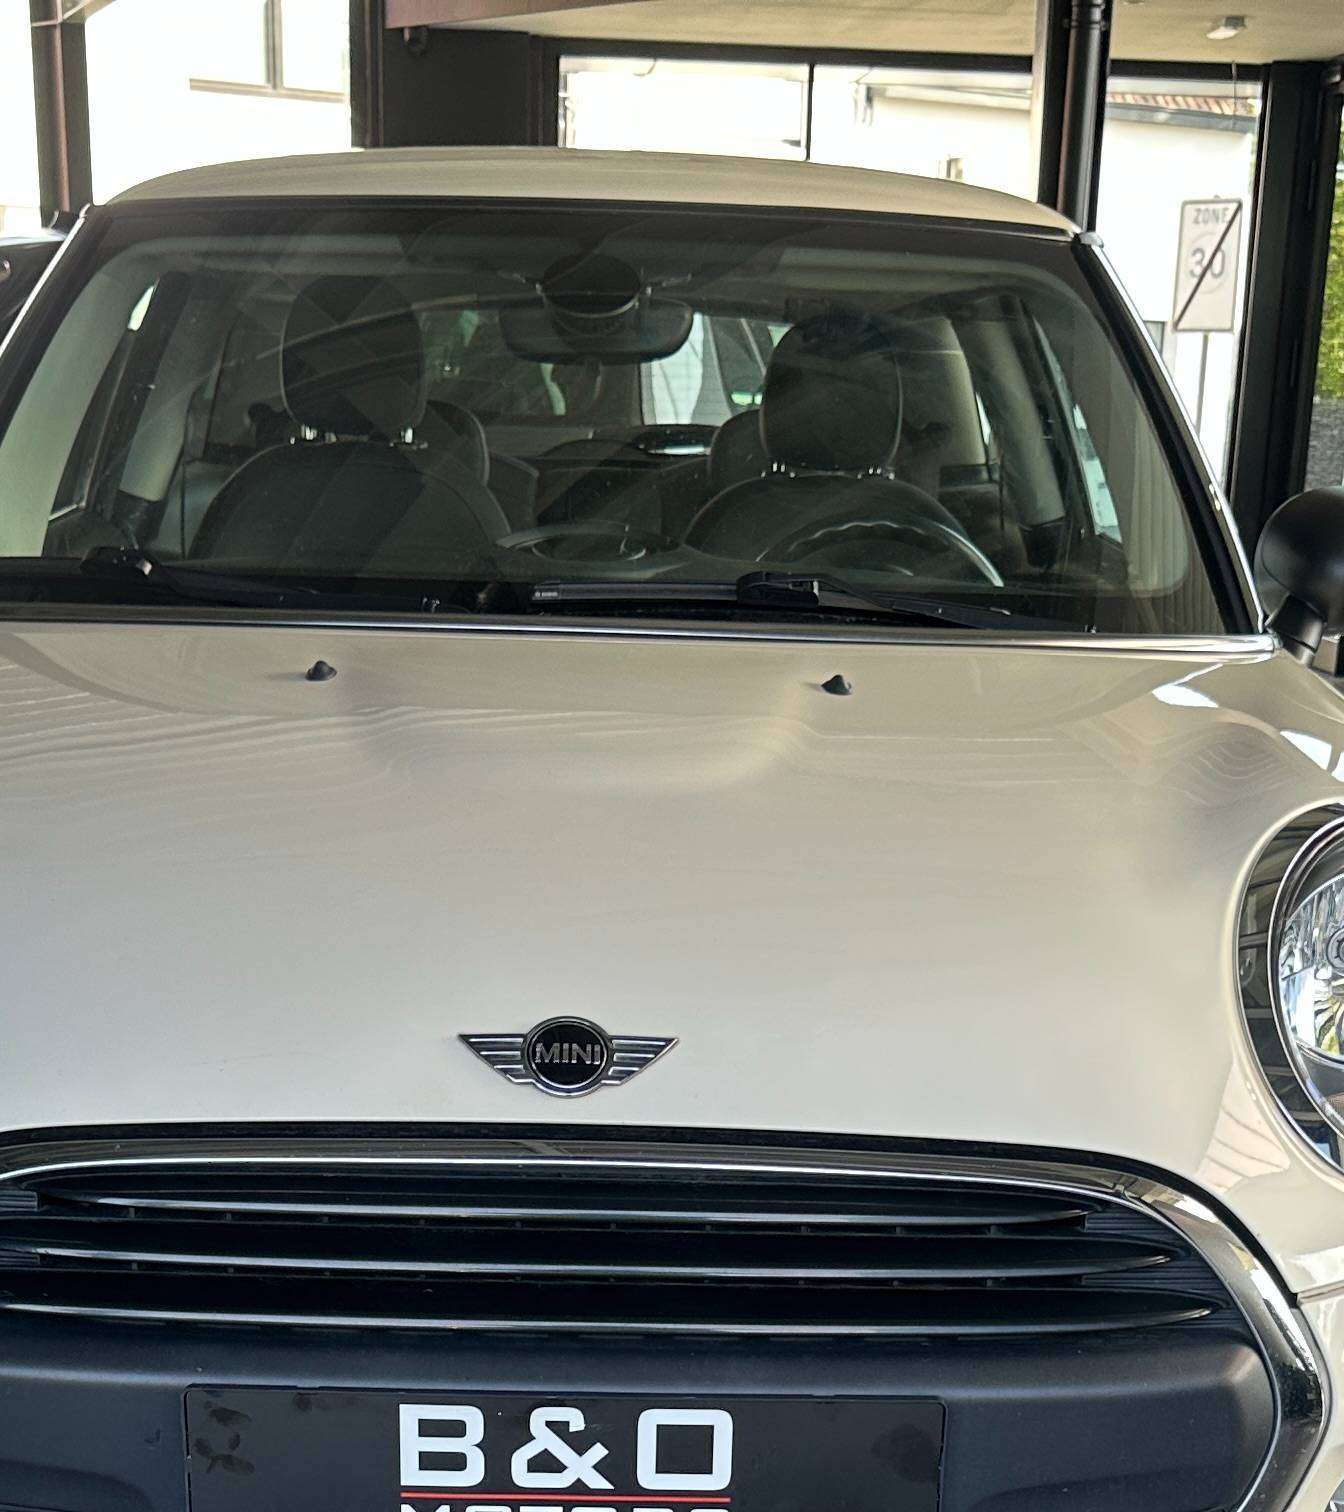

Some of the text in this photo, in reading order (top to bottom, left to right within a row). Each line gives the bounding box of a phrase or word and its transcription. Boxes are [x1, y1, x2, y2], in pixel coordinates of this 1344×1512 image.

[1193, 207, 1229, 225] ZONE
[1189, 247, 1225, 279] 30
[534, 1042, 601, 1065] MINI
[399, 1402, 733, 1491] B&O
